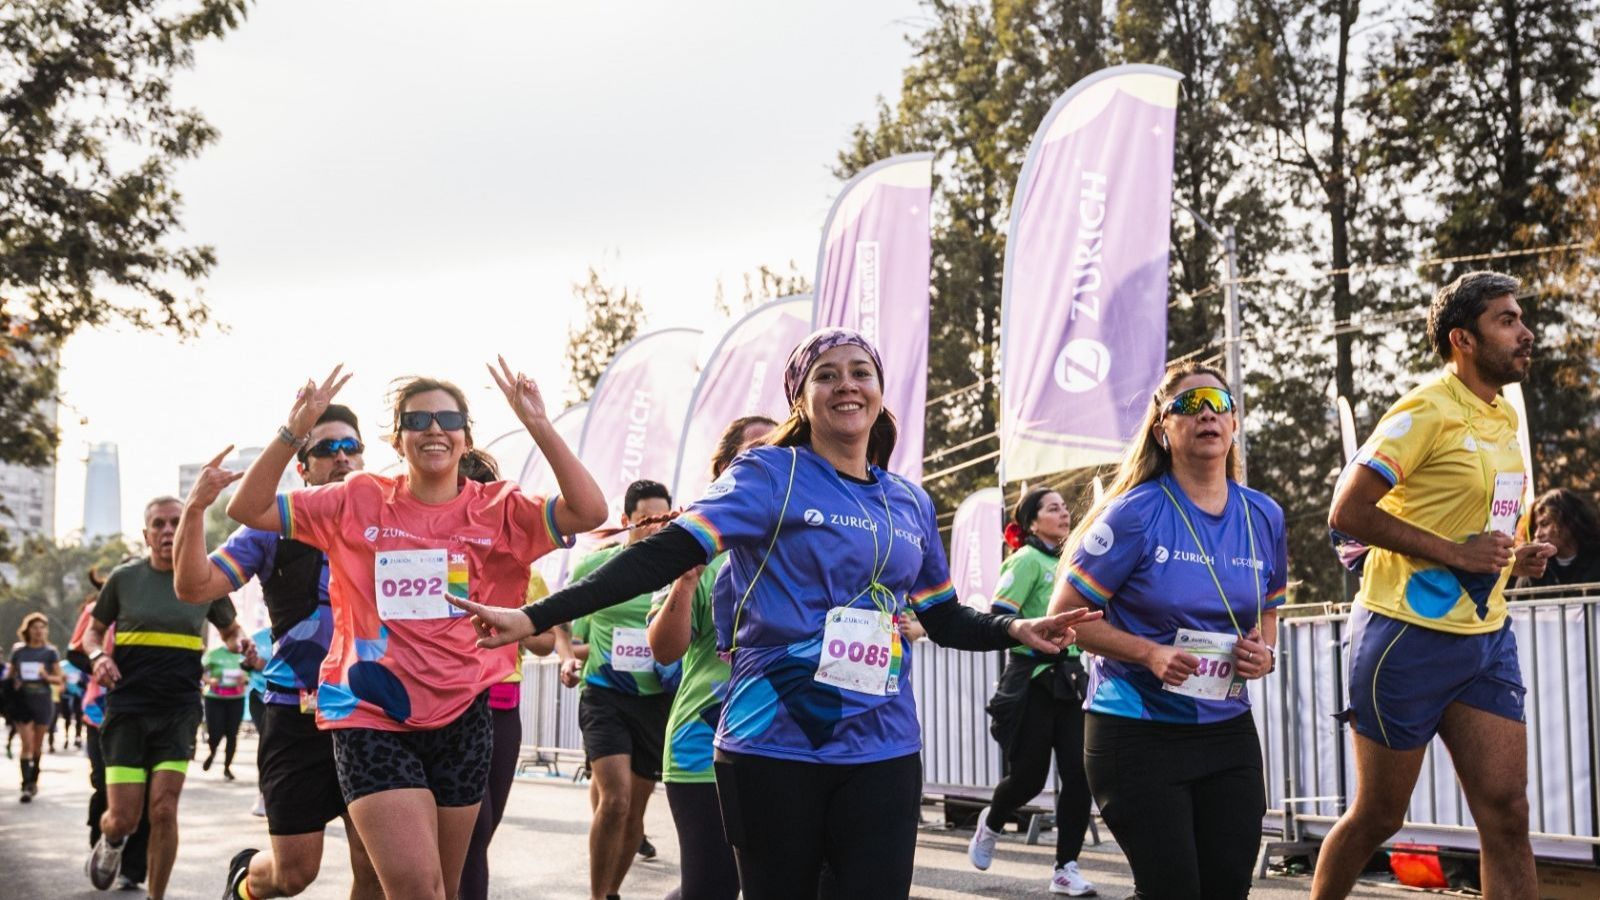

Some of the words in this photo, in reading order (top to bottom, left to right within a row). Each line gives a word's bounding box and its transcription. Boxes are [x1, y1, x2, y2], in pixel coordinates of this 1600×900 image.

[1070, 171, 1107, 322] ZURICH
[620, 389, 651, 482] ZURICH
[1492, 499, 1518, 517] 0594
[830, 513, 878, 532] ZURICH
[451, 553, 465, 564] 3K
[1173, 551, 1215, 565] ZURICH
[382, 577, 442, 597] 0292
[616, 645, 651, 657] 0225
[828, 639, 890, 668] 0085
[1199, 657, 1232, 678] 410
